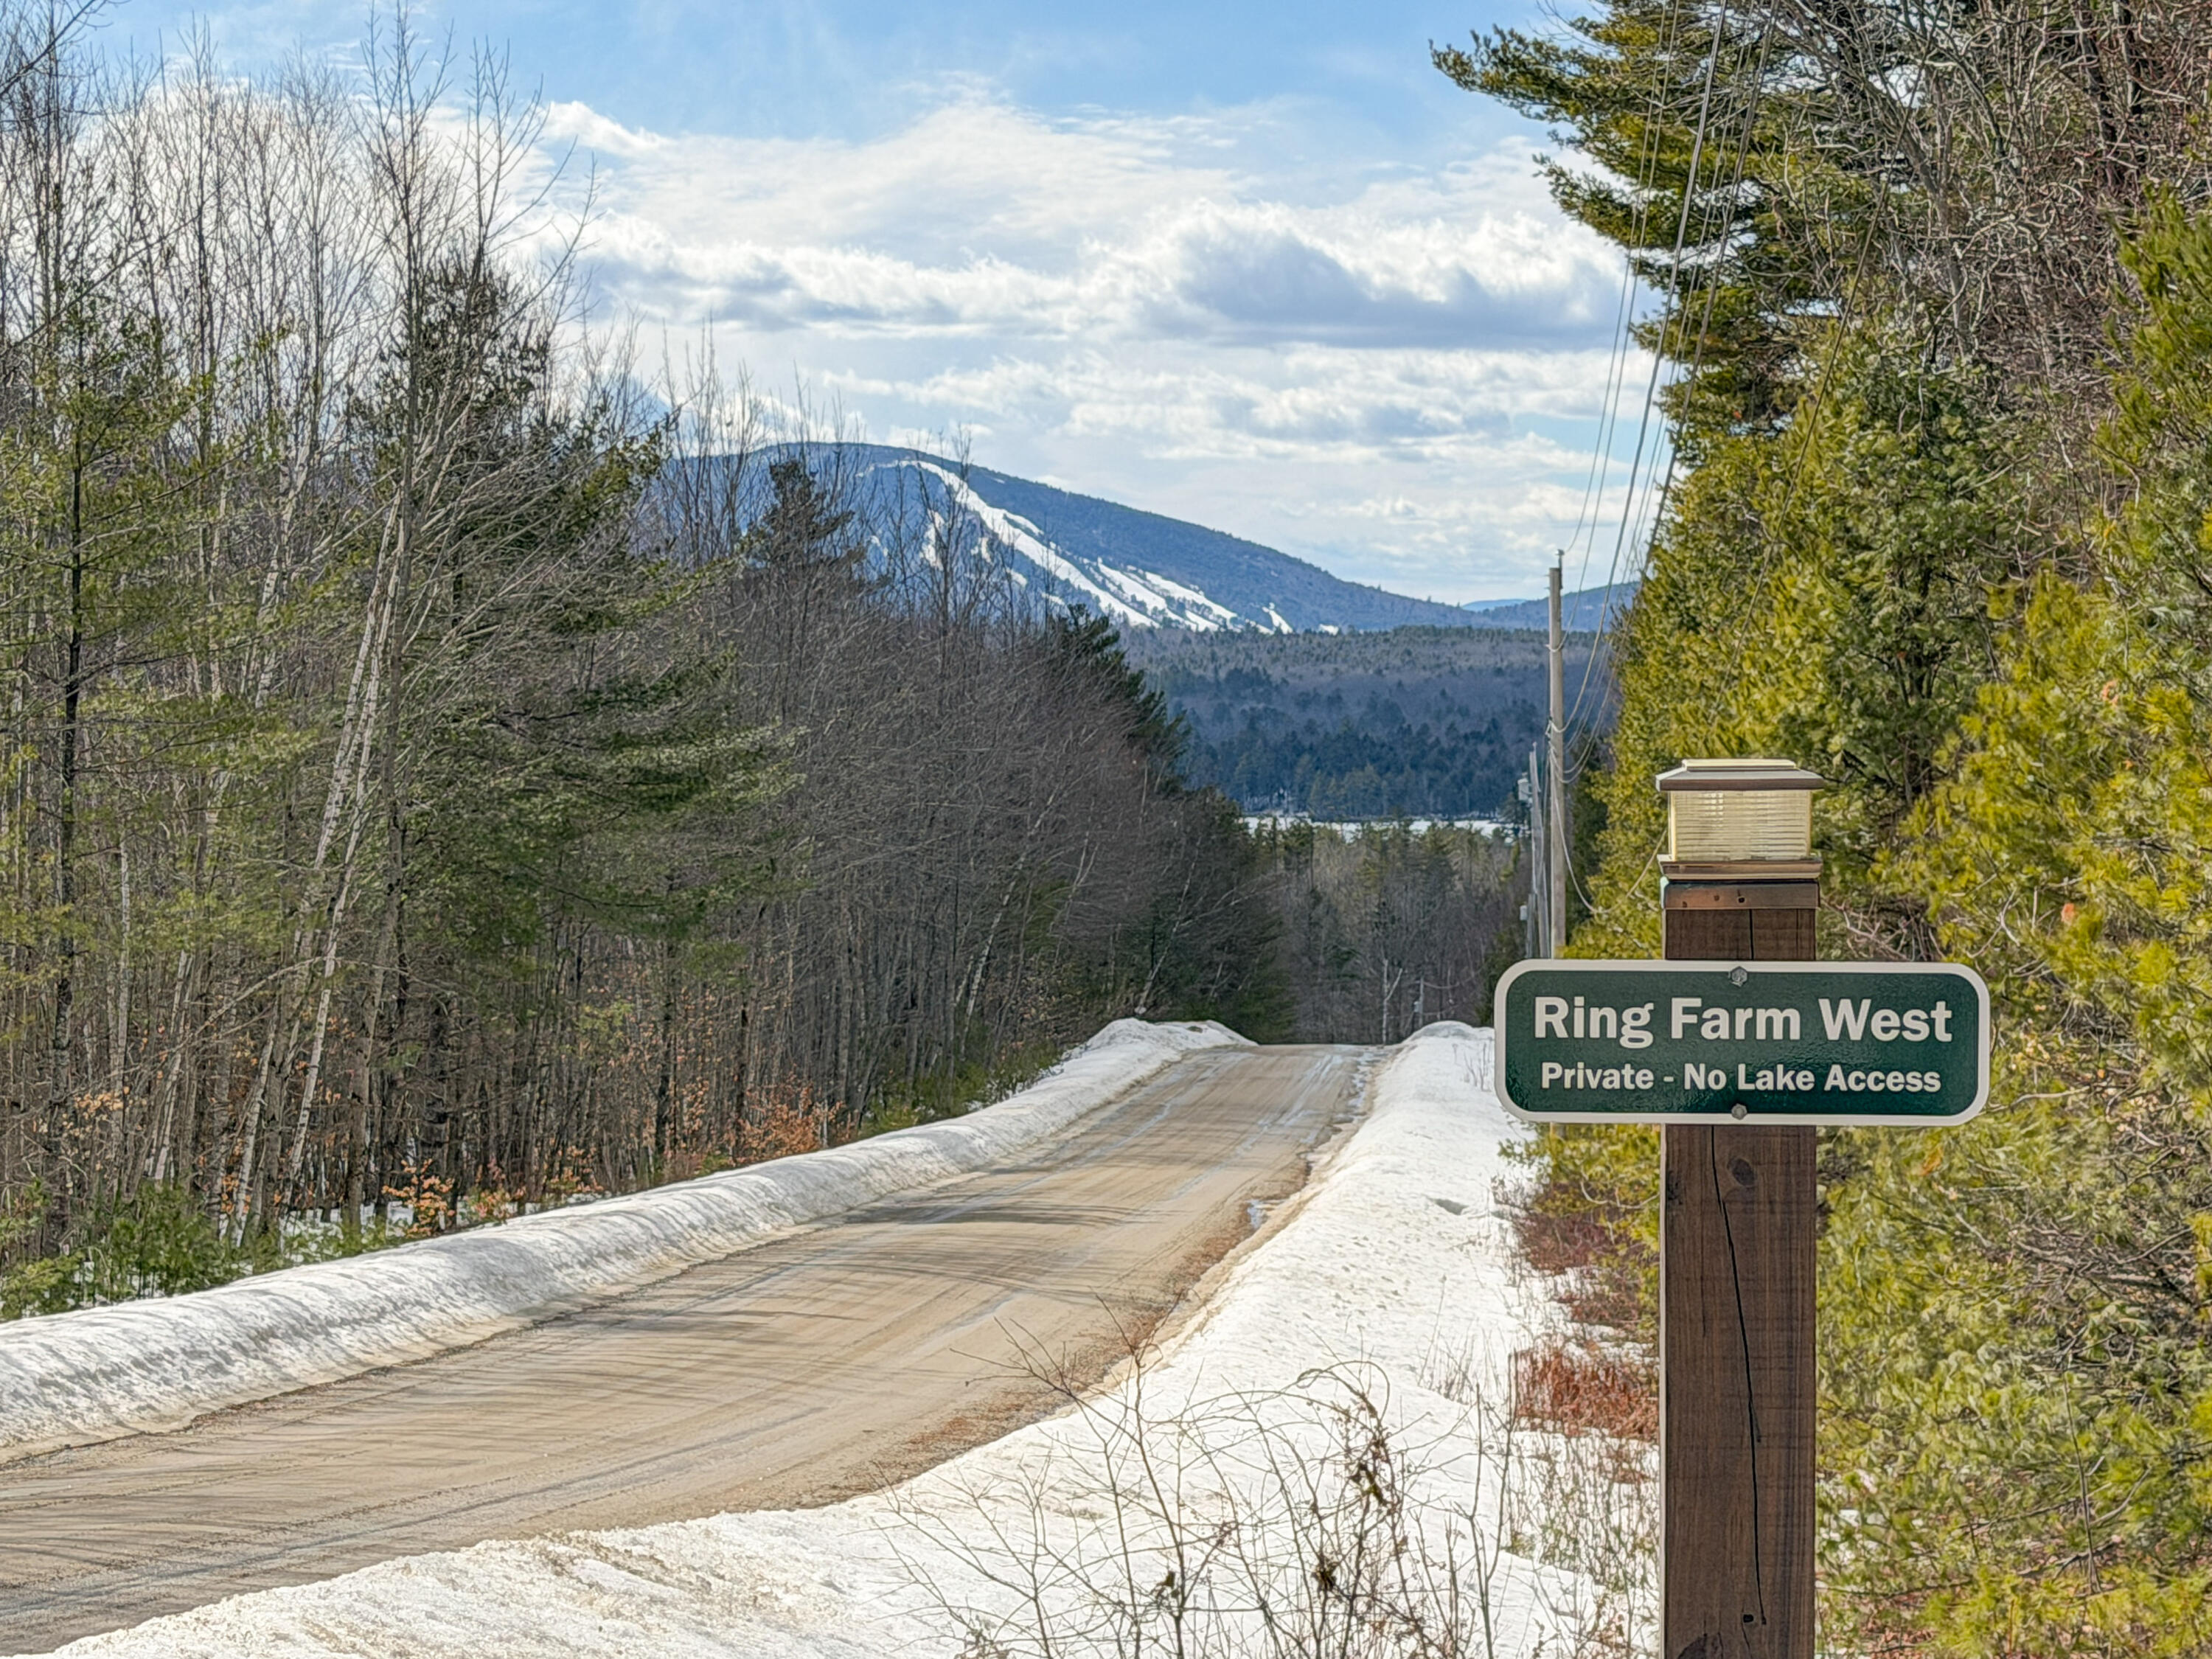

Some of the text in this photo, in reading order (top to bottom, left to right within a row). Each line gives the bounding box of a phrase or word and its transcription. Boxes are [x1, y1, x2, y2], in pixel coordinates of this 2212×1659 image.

[1534, 996, 1952, 1048] Ring Farm West
[1542, 1062, 1654, 1090] Private
[1684, 1063, 1727, 1090] No
[1738, 1063, 1815, 1091] Lake
[1824, 1064, 1941, 1092] Access
